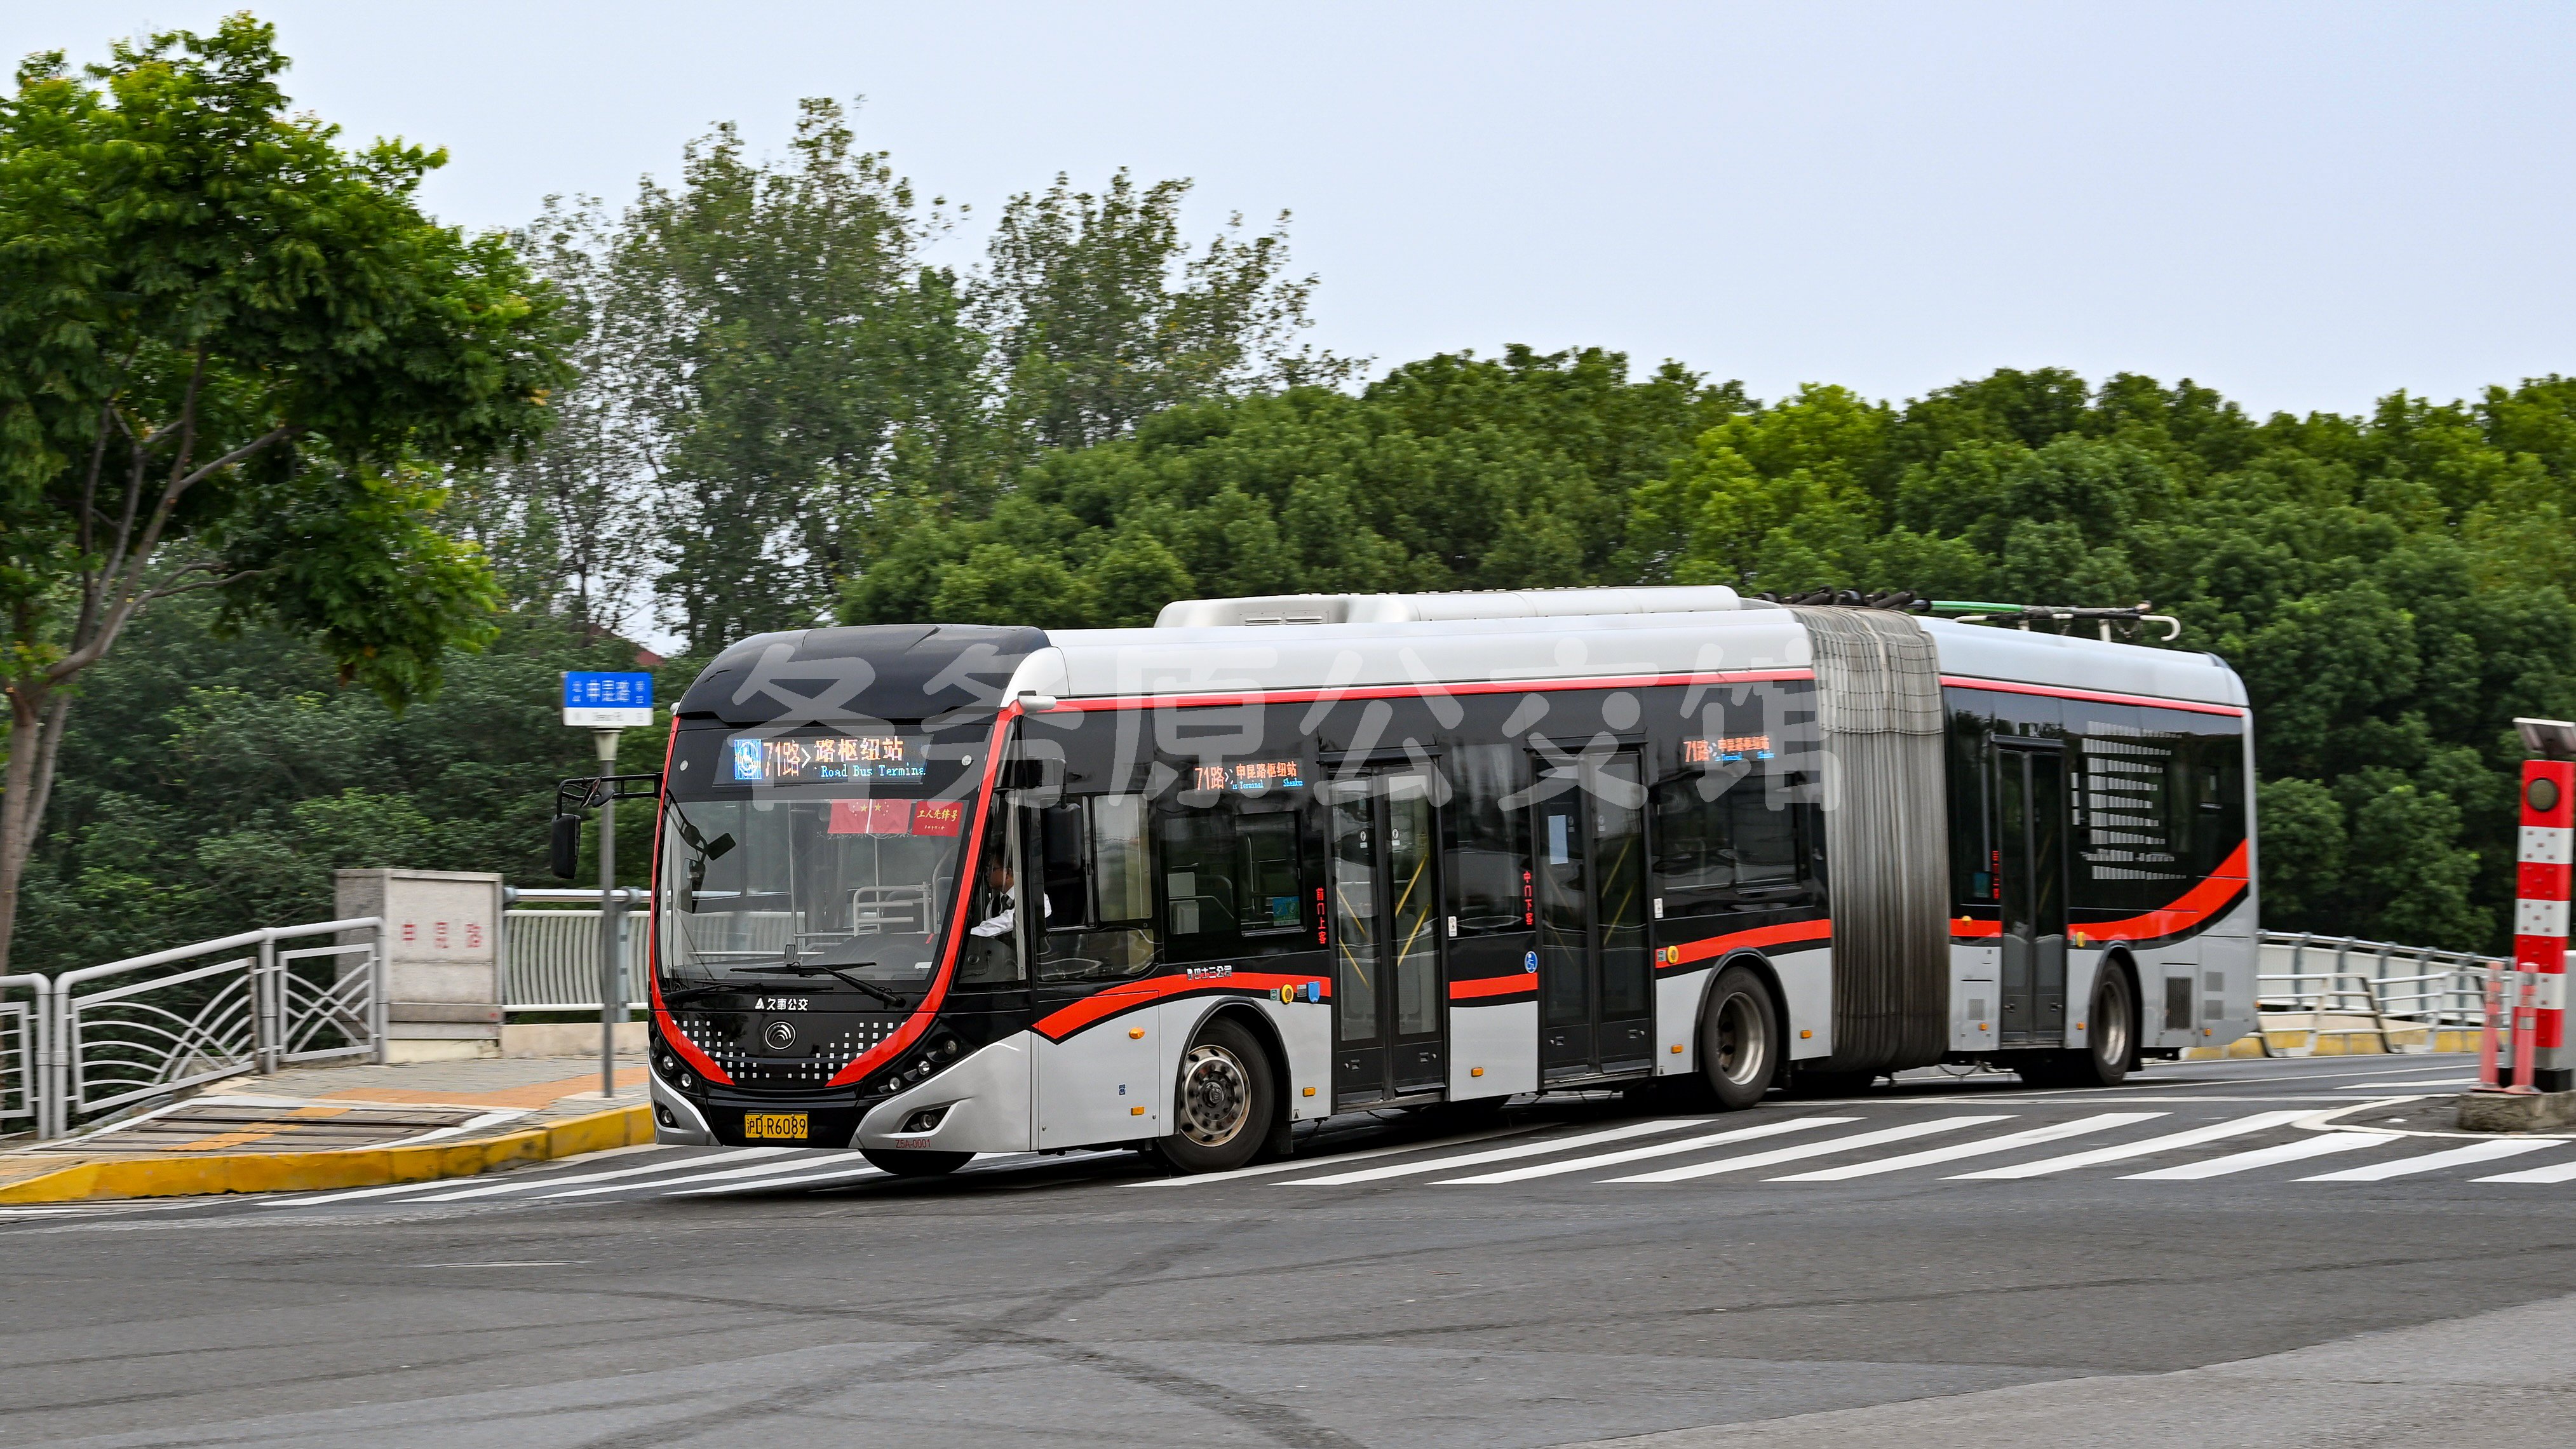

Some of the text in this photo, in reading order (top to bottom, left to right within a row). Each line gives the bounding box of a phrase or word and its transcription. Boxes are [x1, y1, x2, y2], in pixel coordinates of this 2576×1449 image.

[763, 736, 904, 777] 71路 路枢纽站
[821, 764, 848, 778] Road
[853, 765, 873, 777] Bus
[1195, 760, 1297, 791] 71路 申昆路枢纽站
[917, 808, 958, 822] 工人先锋号
[1316, 887, 1326, 944] 前门上客
[895, 1138, 931, 1149] Z5A-0001
